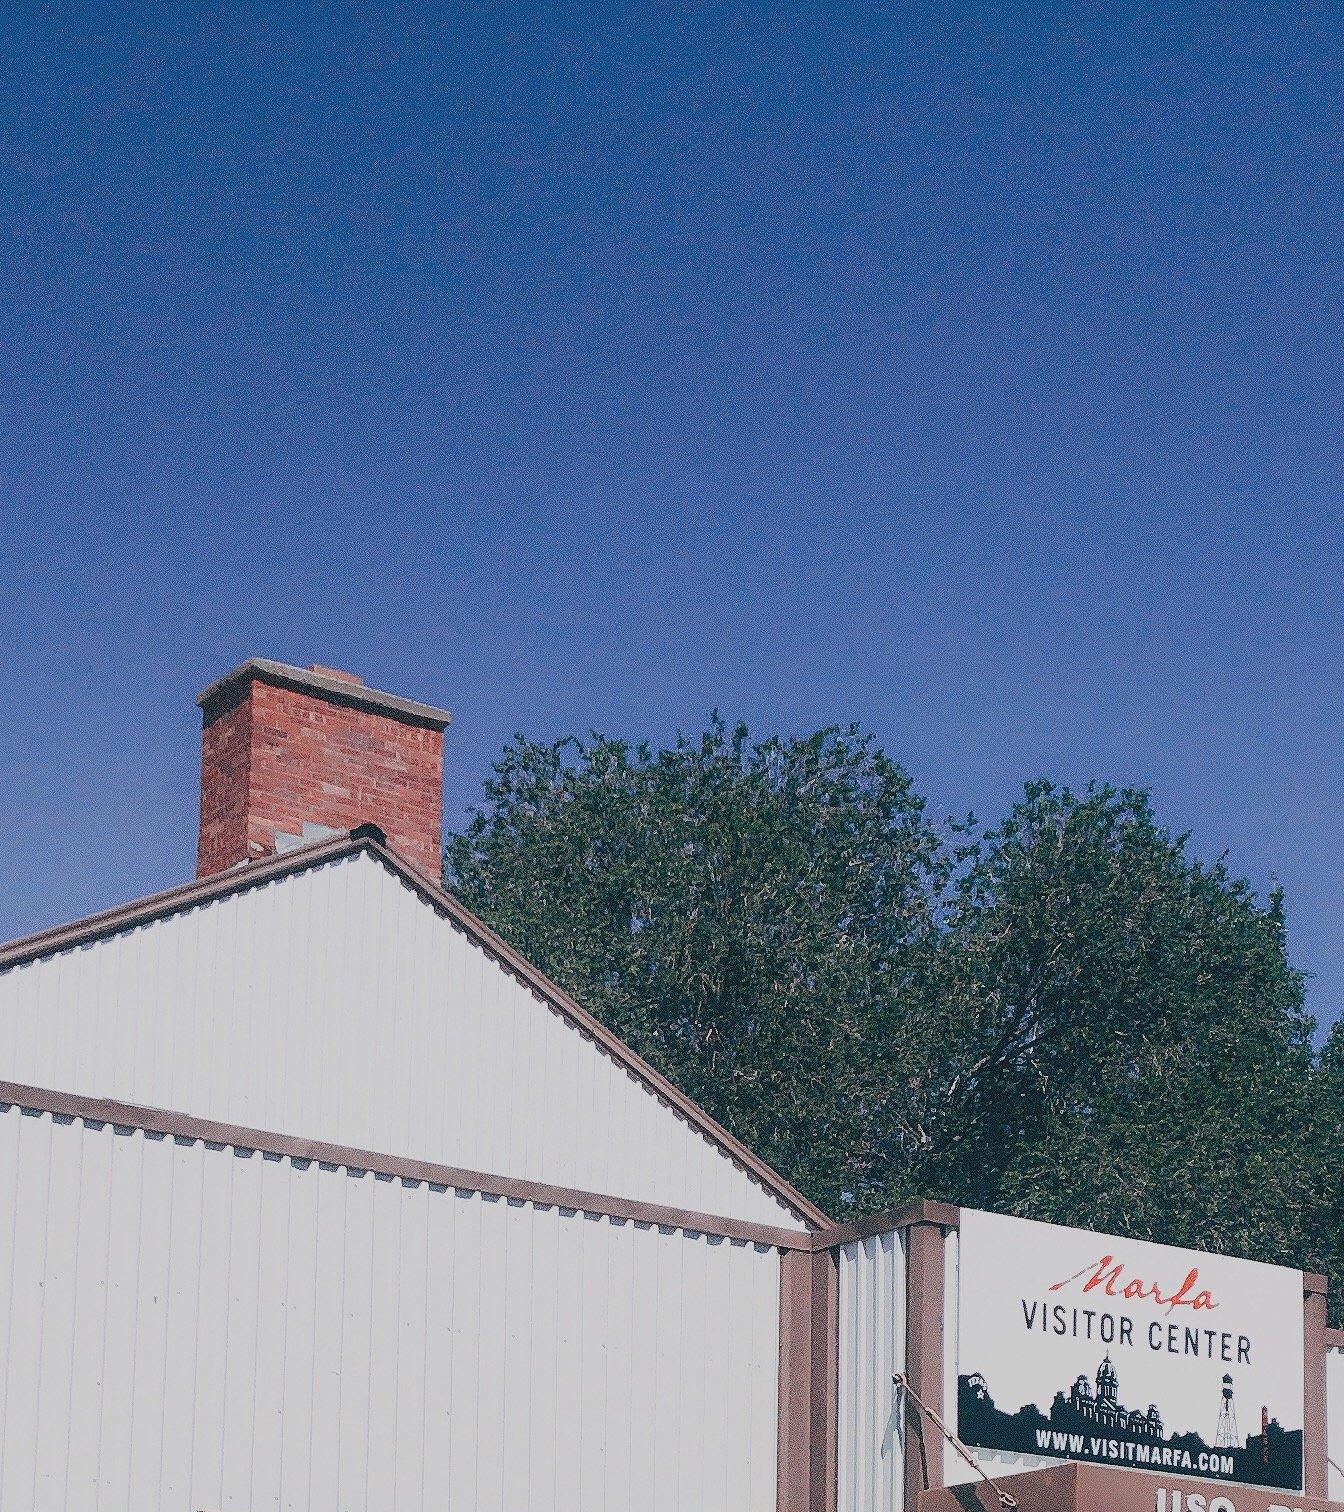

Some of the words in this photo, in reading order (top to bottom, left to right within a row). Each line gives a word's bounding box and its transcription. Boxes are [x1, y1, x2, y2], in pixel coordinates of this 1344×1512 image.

[1049, 1255, 1219, 1316] Marfa
[1021, 1299, 1134, 1347] VISITOR
[1148, 1321, 1252, 1365] CENTER
[1035, 1428, 1234, 1475] WWW.VISITMARFA.COM
